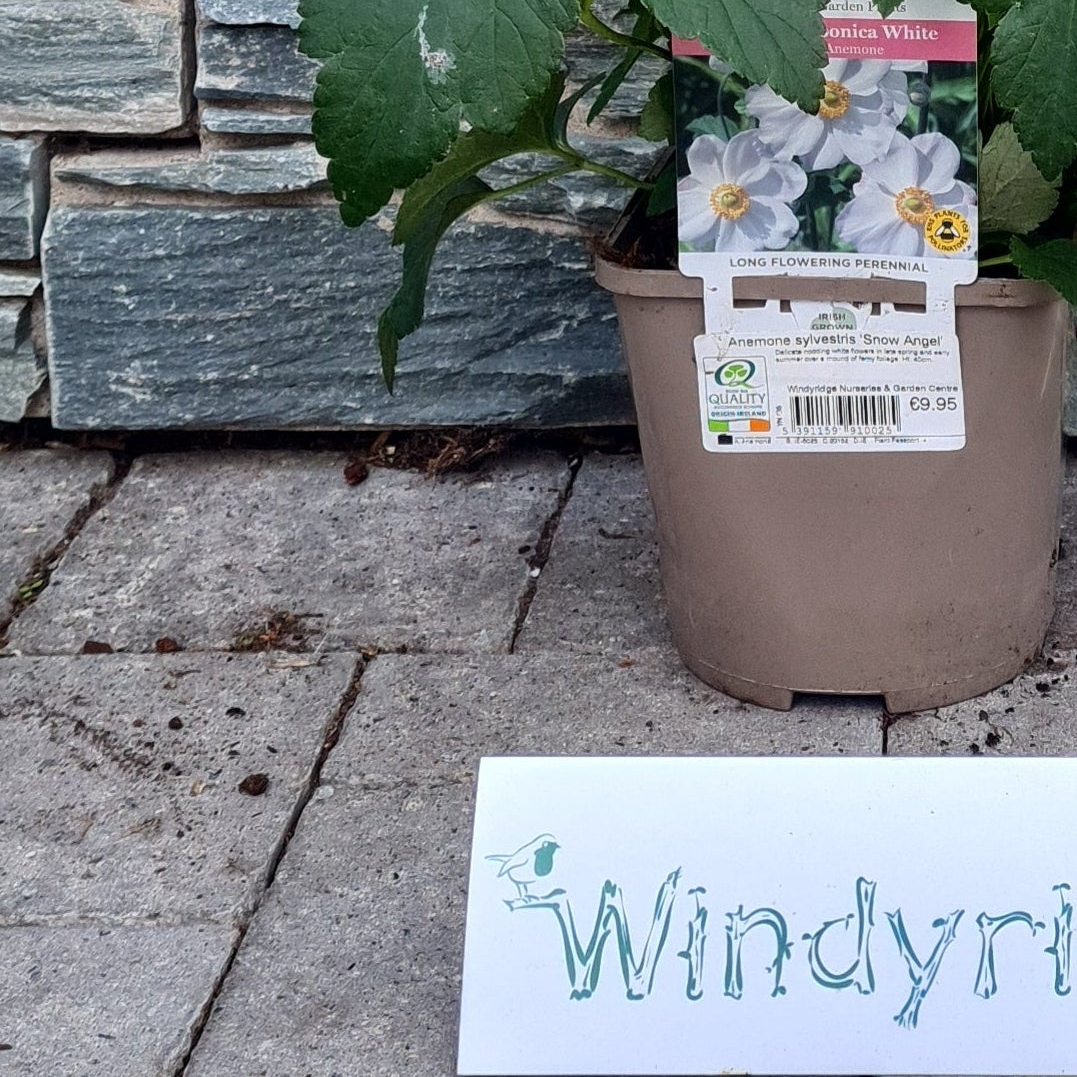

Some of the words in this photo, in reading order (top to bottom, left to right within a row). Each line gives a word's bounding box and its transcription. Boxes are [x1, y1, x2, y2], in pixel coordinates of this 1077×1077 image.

[824, 0, 863, 12] arden
[882, 25, 939, 40] White
[827, 44, 884, 56] Anemone
[730, 257, 767, 268] LONG
[771, 257, 851, 268] FLOWERING
[855, 258, 929, 273] PERENNIAL
[818, 312, 846, 321] IRISH
[728, 336, 791, 348] Anemone
[795, 333, 856, 349] sylvestris
[860, 333, 900, 346] 'Snow
[904, 335, 943, 349] Angel'
[786, 384, 838, 395] Windyridge
[839, 384, 882, 393] Nurseries
[884, 384, 891, 393] &
[893, 384, 927, 394] Garden
[929, 385, 959, 393] Centre
[708, 393, 766, 405] QUALITY
[909, 396, 958, 412] €9.95
